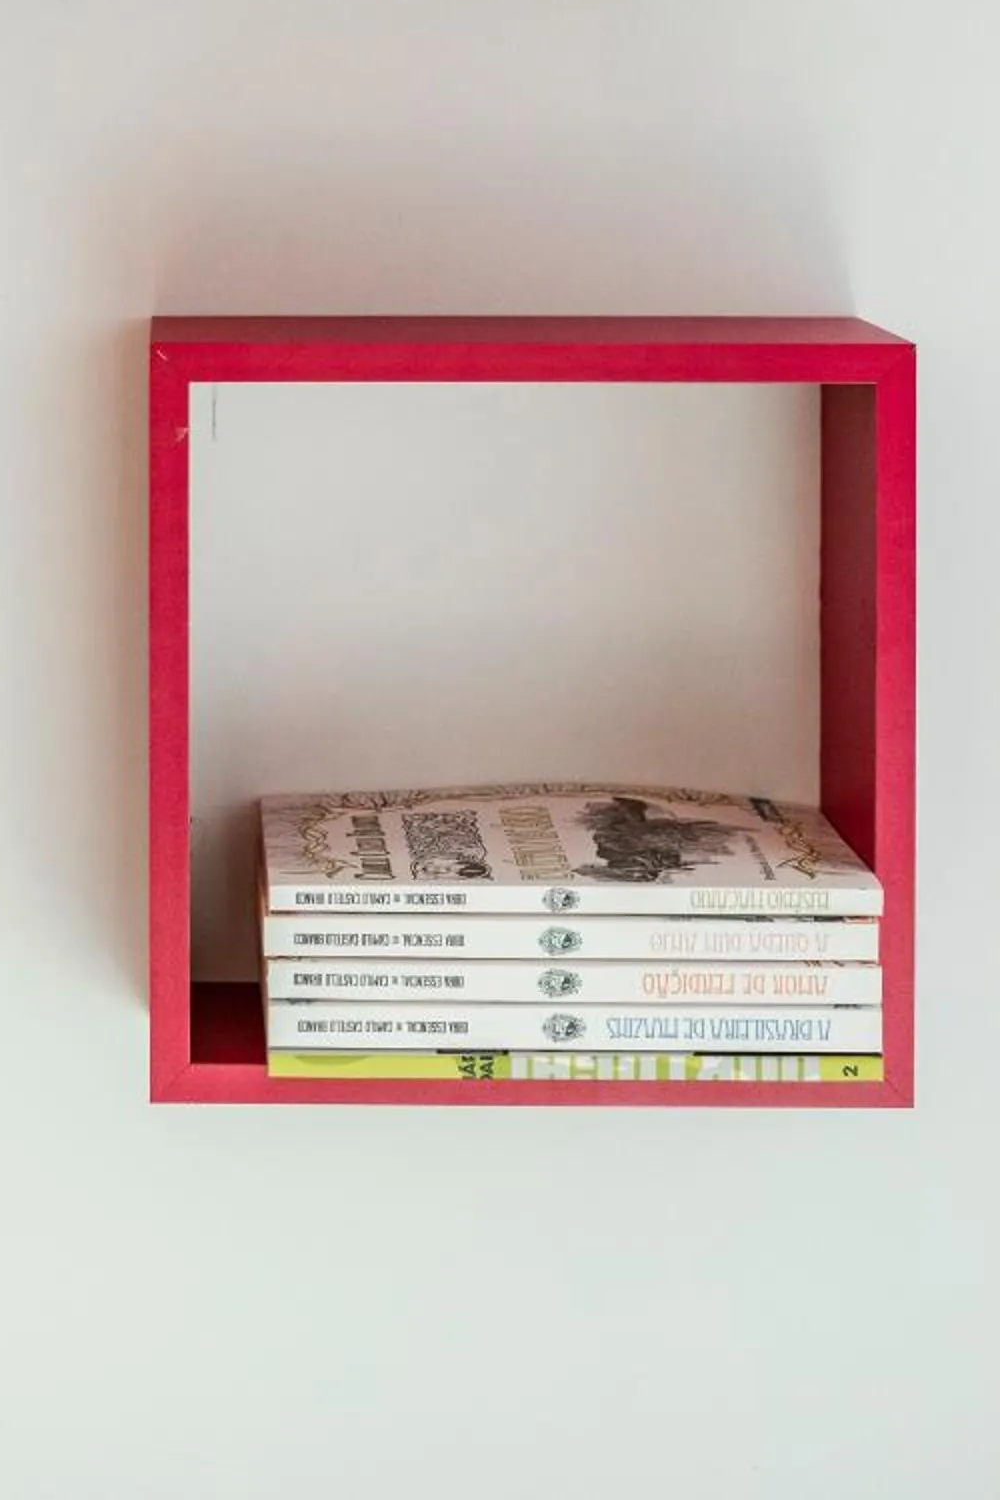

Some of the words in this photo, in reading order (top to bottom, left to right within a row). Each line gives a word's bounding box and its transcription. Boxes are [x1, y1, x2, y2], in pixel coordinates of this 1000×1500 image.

[742, 975, 765, 994] DE
[684, 1018, 705, 1040] DE
[710, 1018, 813, 1040] BRASILEIRA
[842, 1065, 859, 1077] 2
